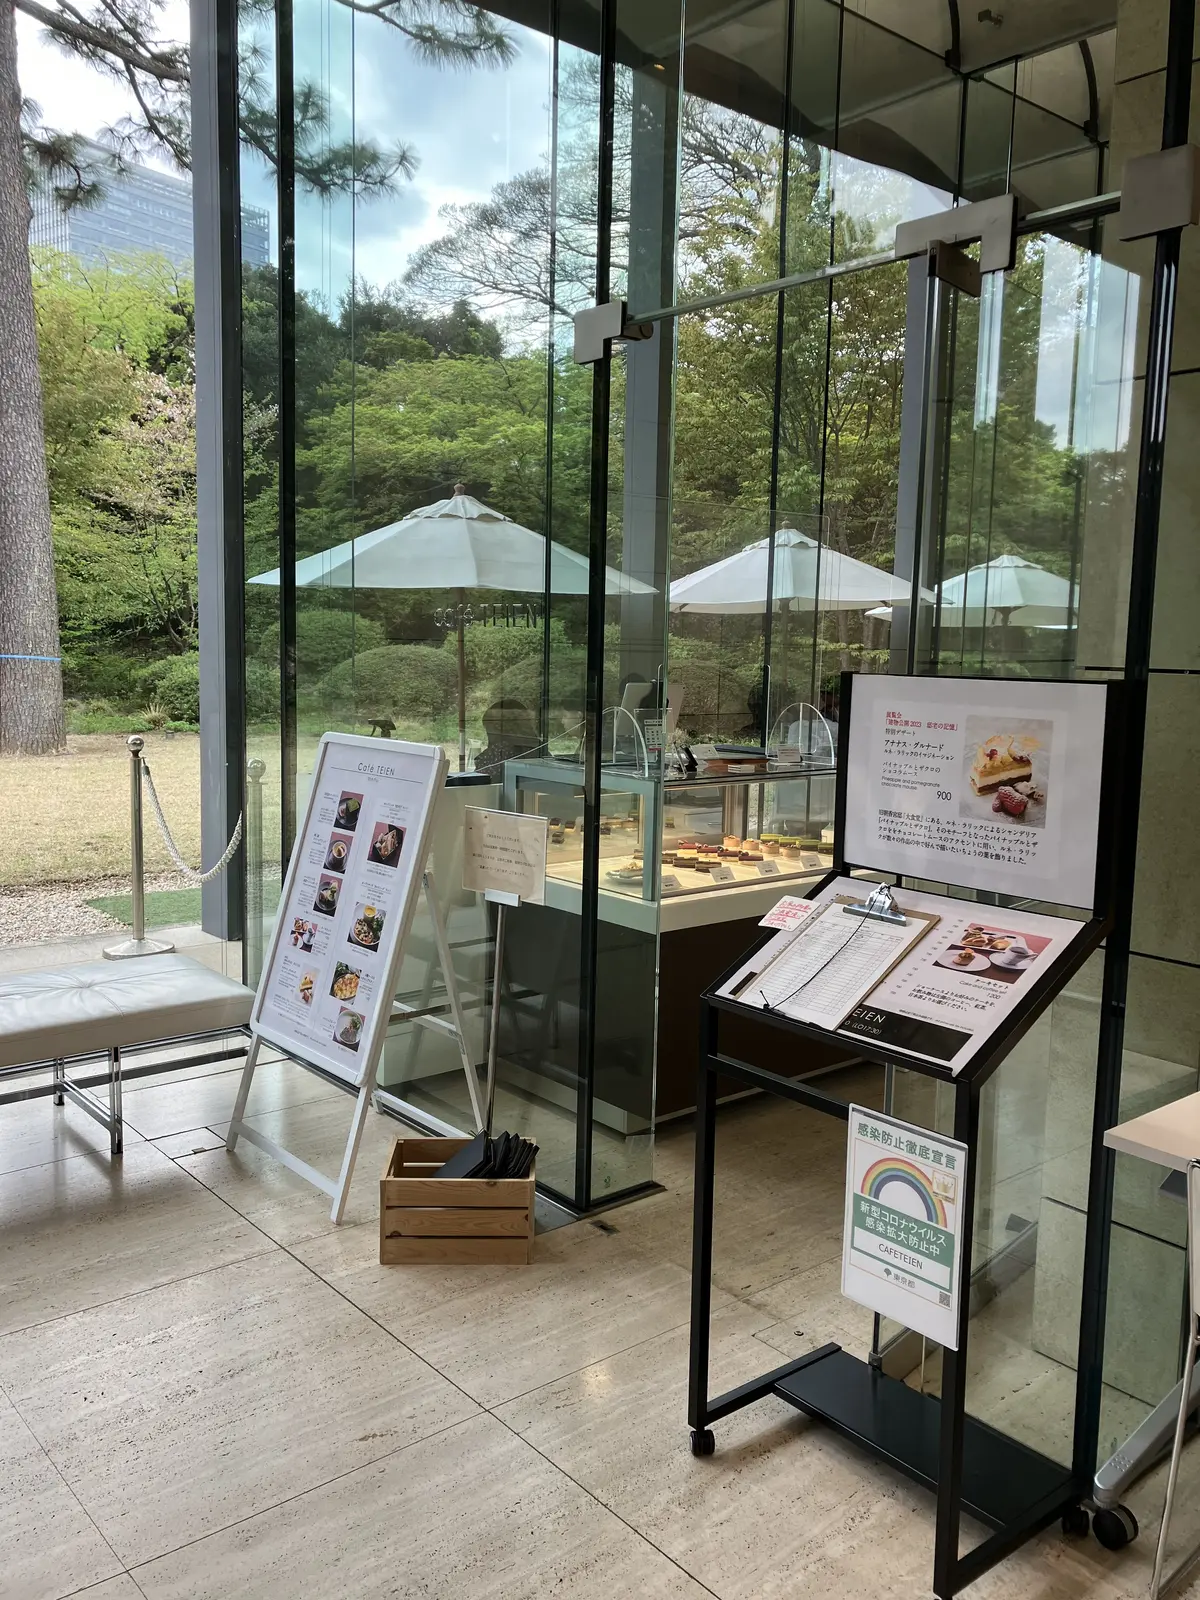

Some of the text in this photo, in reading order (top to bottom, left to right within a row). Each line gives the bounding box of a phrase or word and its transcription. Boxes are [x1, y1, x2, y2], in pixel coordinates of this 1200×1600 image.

[479, 603, 537, 628] TEIEN
[357, 762, 396, 776] Café TEIEN
[936, 790, 952, 801] 900
[986, 992, 1001, 1000] 1200
[851, 1007, 886, 1024] EIEN
[857, 1121, 957, 1171] 感染防止徹底宣言
[860, 1200, 948, 1248] 新型コロナウイルス
[865, 1216, 940, 1257] 感染拡大防止中
[878, 1243, 924, 1270] CAFETEIEN
[893, 1272, 916, 1289] 東京都
